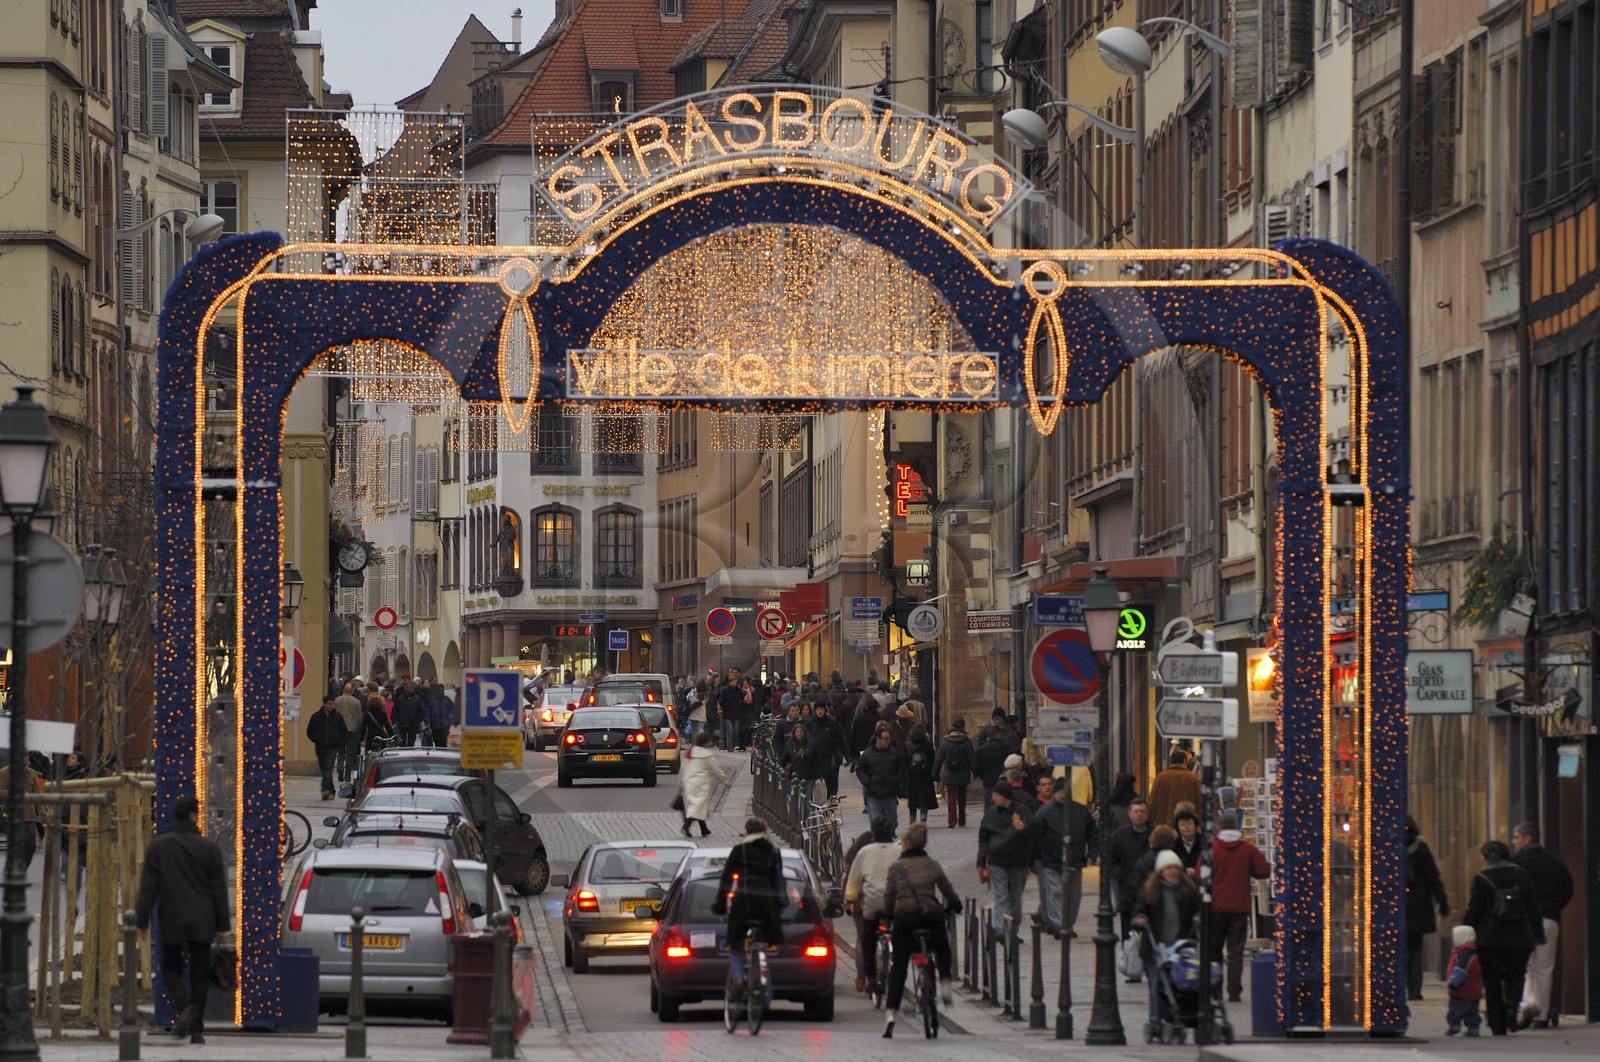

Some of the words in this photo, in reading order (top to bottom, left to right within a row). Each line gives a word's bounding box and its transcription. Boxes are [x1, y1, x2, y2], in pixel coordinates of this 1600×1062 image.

[546, 90, 1014, 226] STRASBOURG
[569, 337, 676, 397] ville
[696, 339, 769, 397] de
[969, 615, 1002, 623] COMPTOIR
[969, 621, 1011, 629] COTONNIERS
[1116, 639, 1146, 649] AIGLE
[1180, 662, 1220, 681] Gutenberg
[1407, 676, 1444, 687] LBERTO
[479, 681, 505, 718] P
[1416, 686, 1468, 701] CAPORALE
[1164, 710, 1183, 726] Office
[1184, 711, 1192, 726] du
[1194, 710, 1223, 728] Tourisme
